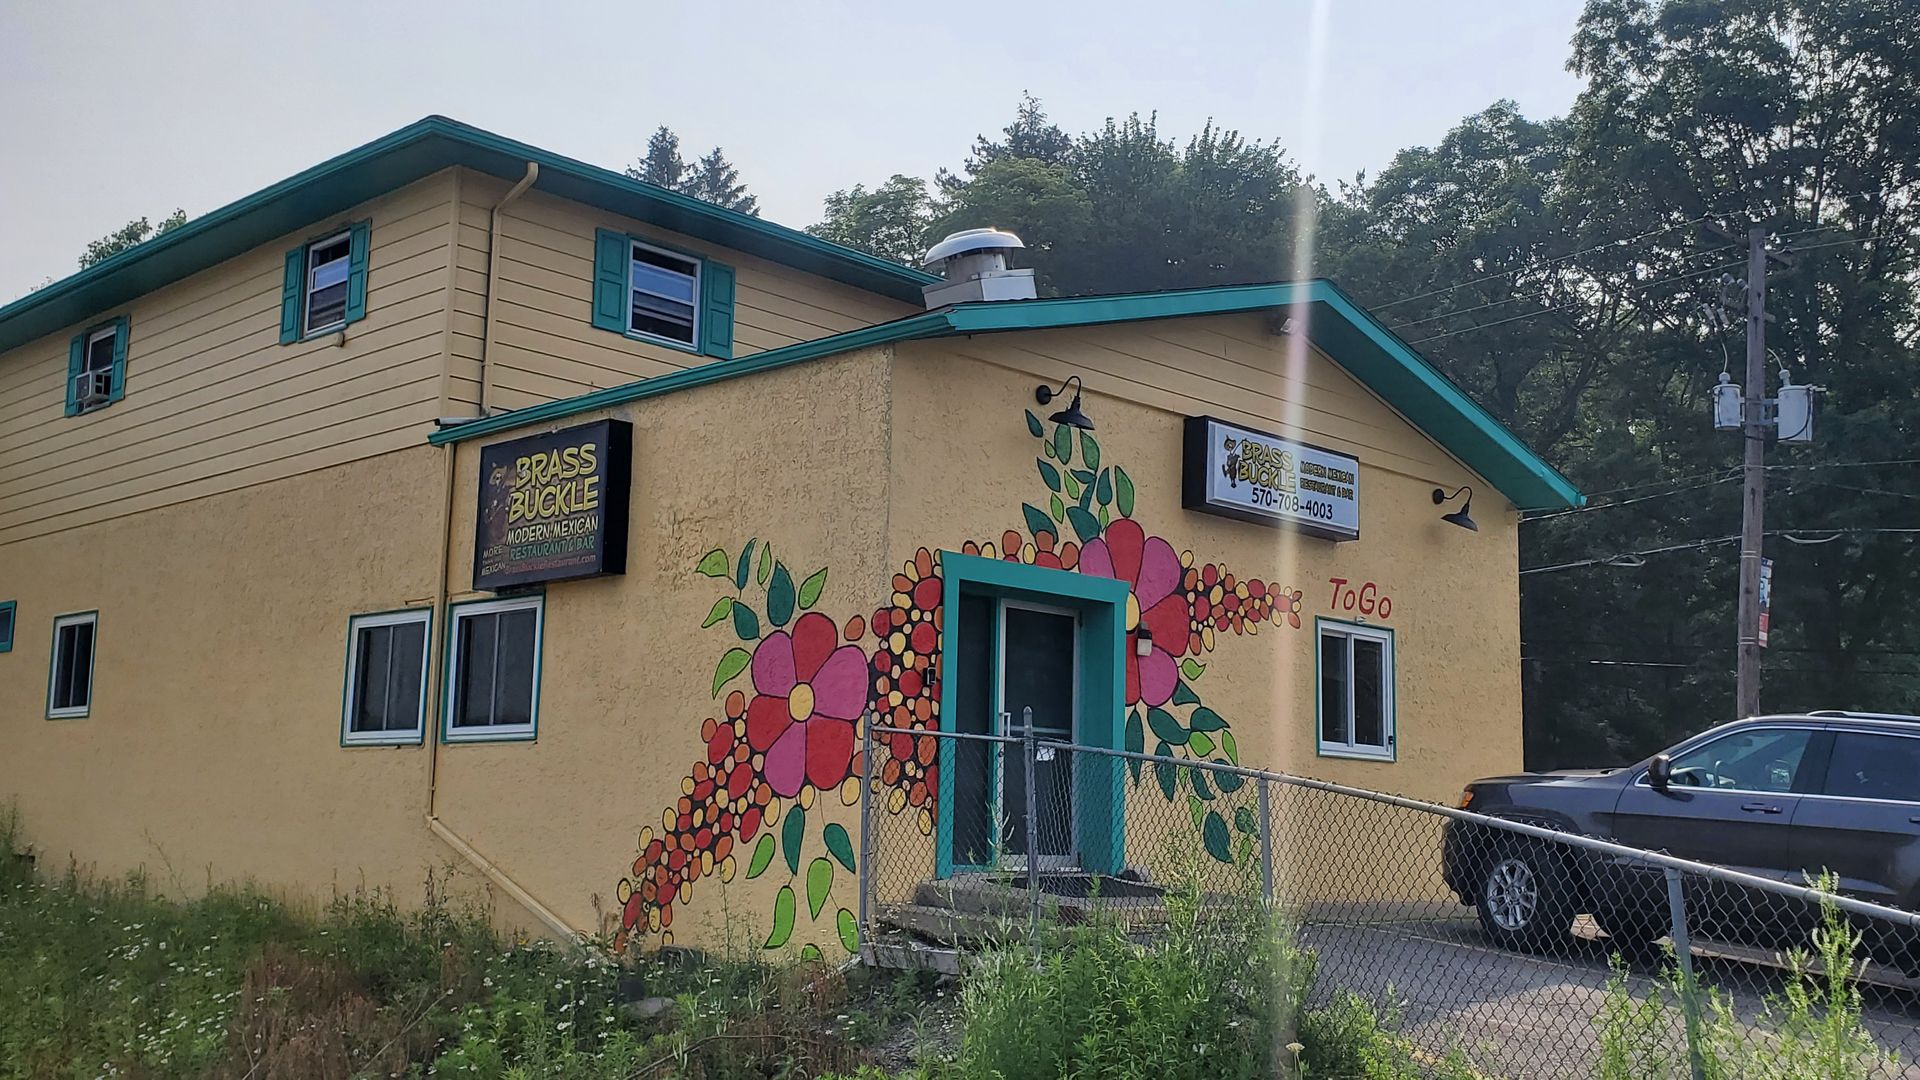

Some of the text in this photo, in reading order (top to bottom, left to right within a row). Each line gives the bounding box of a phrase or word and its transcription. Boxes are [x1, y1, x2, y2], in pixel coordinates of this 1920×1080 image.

[515, 443, 597, 489] BRASS
[1242, 441, 1293, 472] BRASS
[1300, 460, 1326, 479] MODERN
[1238, 460, 1296, 494] BUCKLE
[1300, 477, 1336, 496] RESTAURANT
[508, 475, 600, 524] BUCKLE
[1251, 487, 1333, 520] 570-708-4003
[507, 515, 599, 546] MODERN MEXICAN
[482, 545, 503, 559] MORE
[510, 538, 568, 561] RESTAURANT
[568, 540, 574, 552] &
[577, 536, 595, 551] BAR
[481, 562, 505, 576] MEXICAN
[1328, 577, 1392, 619] ToGo
